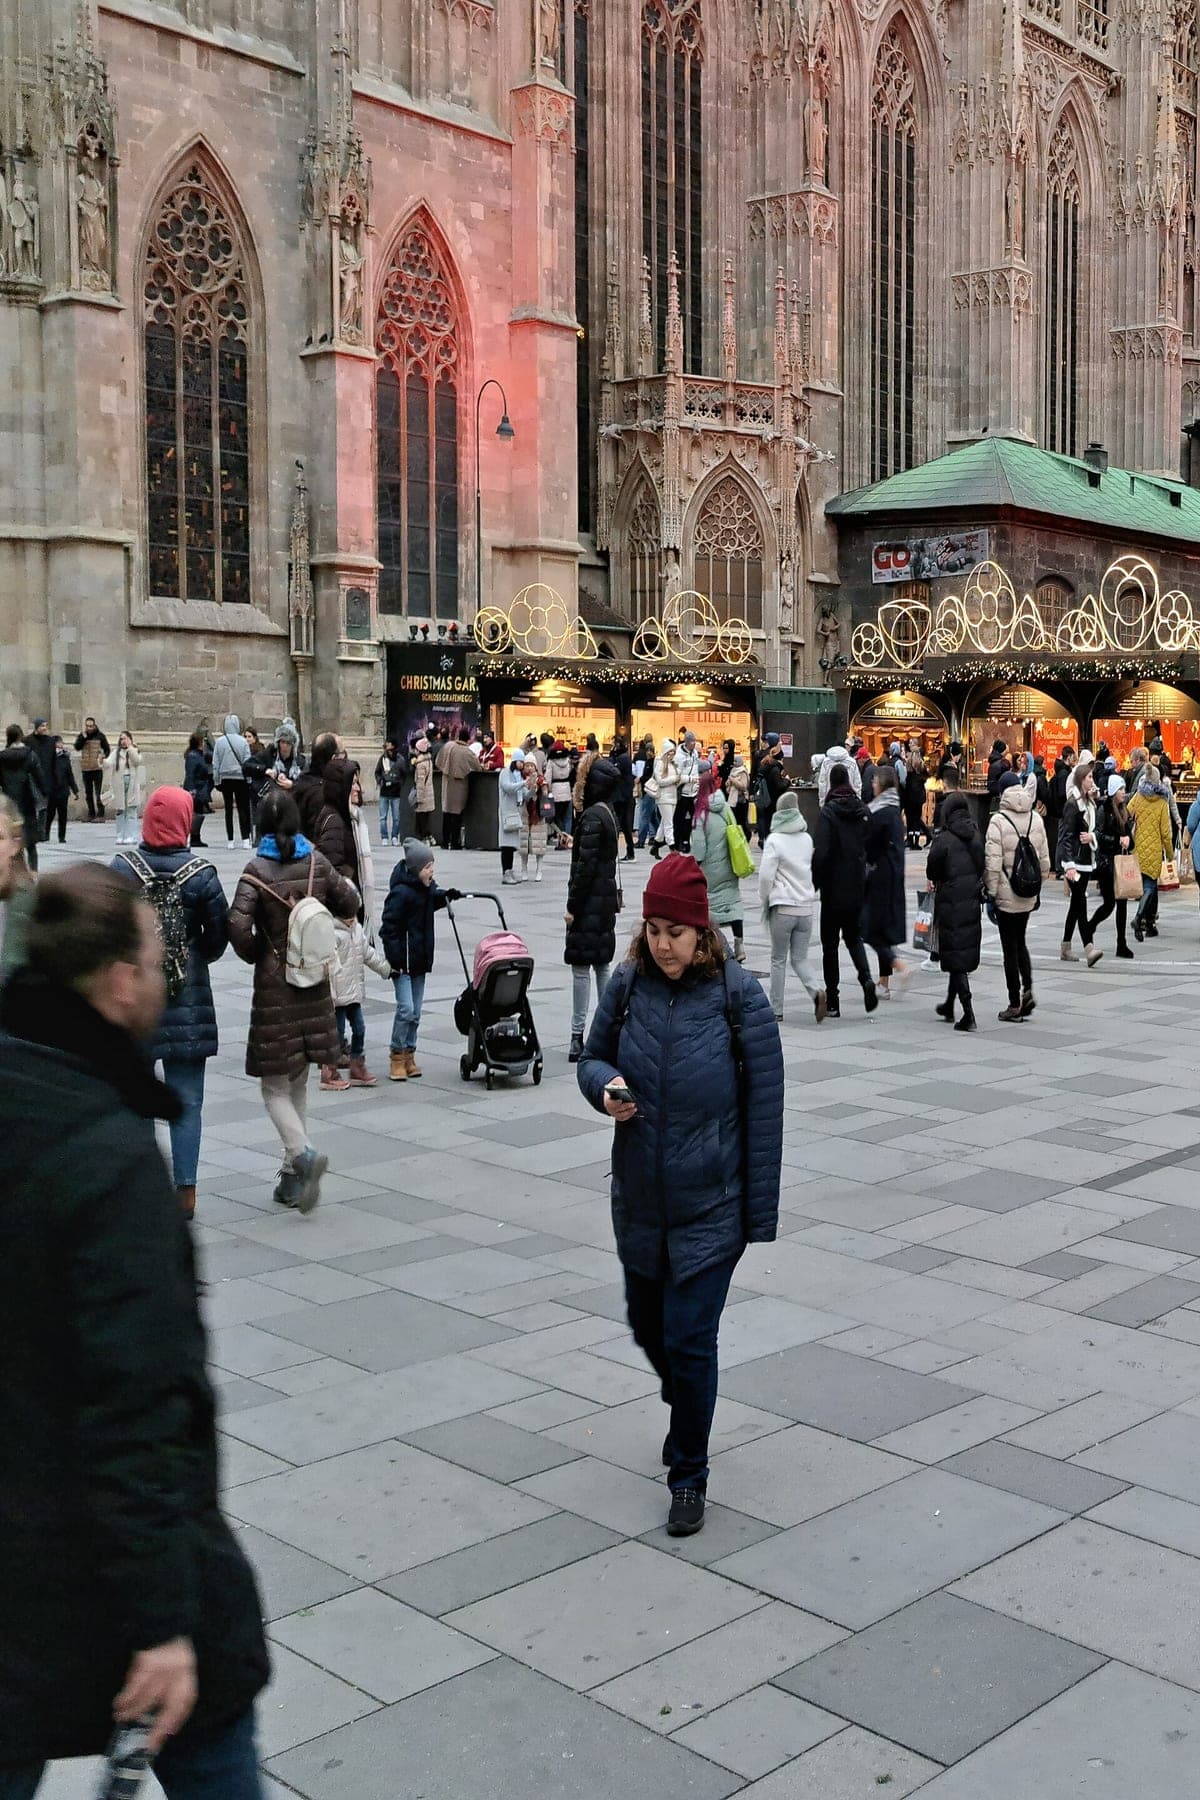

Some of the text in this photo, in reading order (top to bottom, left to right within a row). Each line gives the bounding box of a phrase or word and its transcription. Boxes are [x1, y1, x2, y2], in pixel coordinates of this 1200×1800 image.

[873, 543, 911, 570] GO
[400, 675, 479, 691] CHRISTMAS GAR
[421, 693, 473, 703] SCHLOSS GRAFENEGG
[550, 705, 586, 718] LILLET
[697, 712, 732, 724] LILLET
